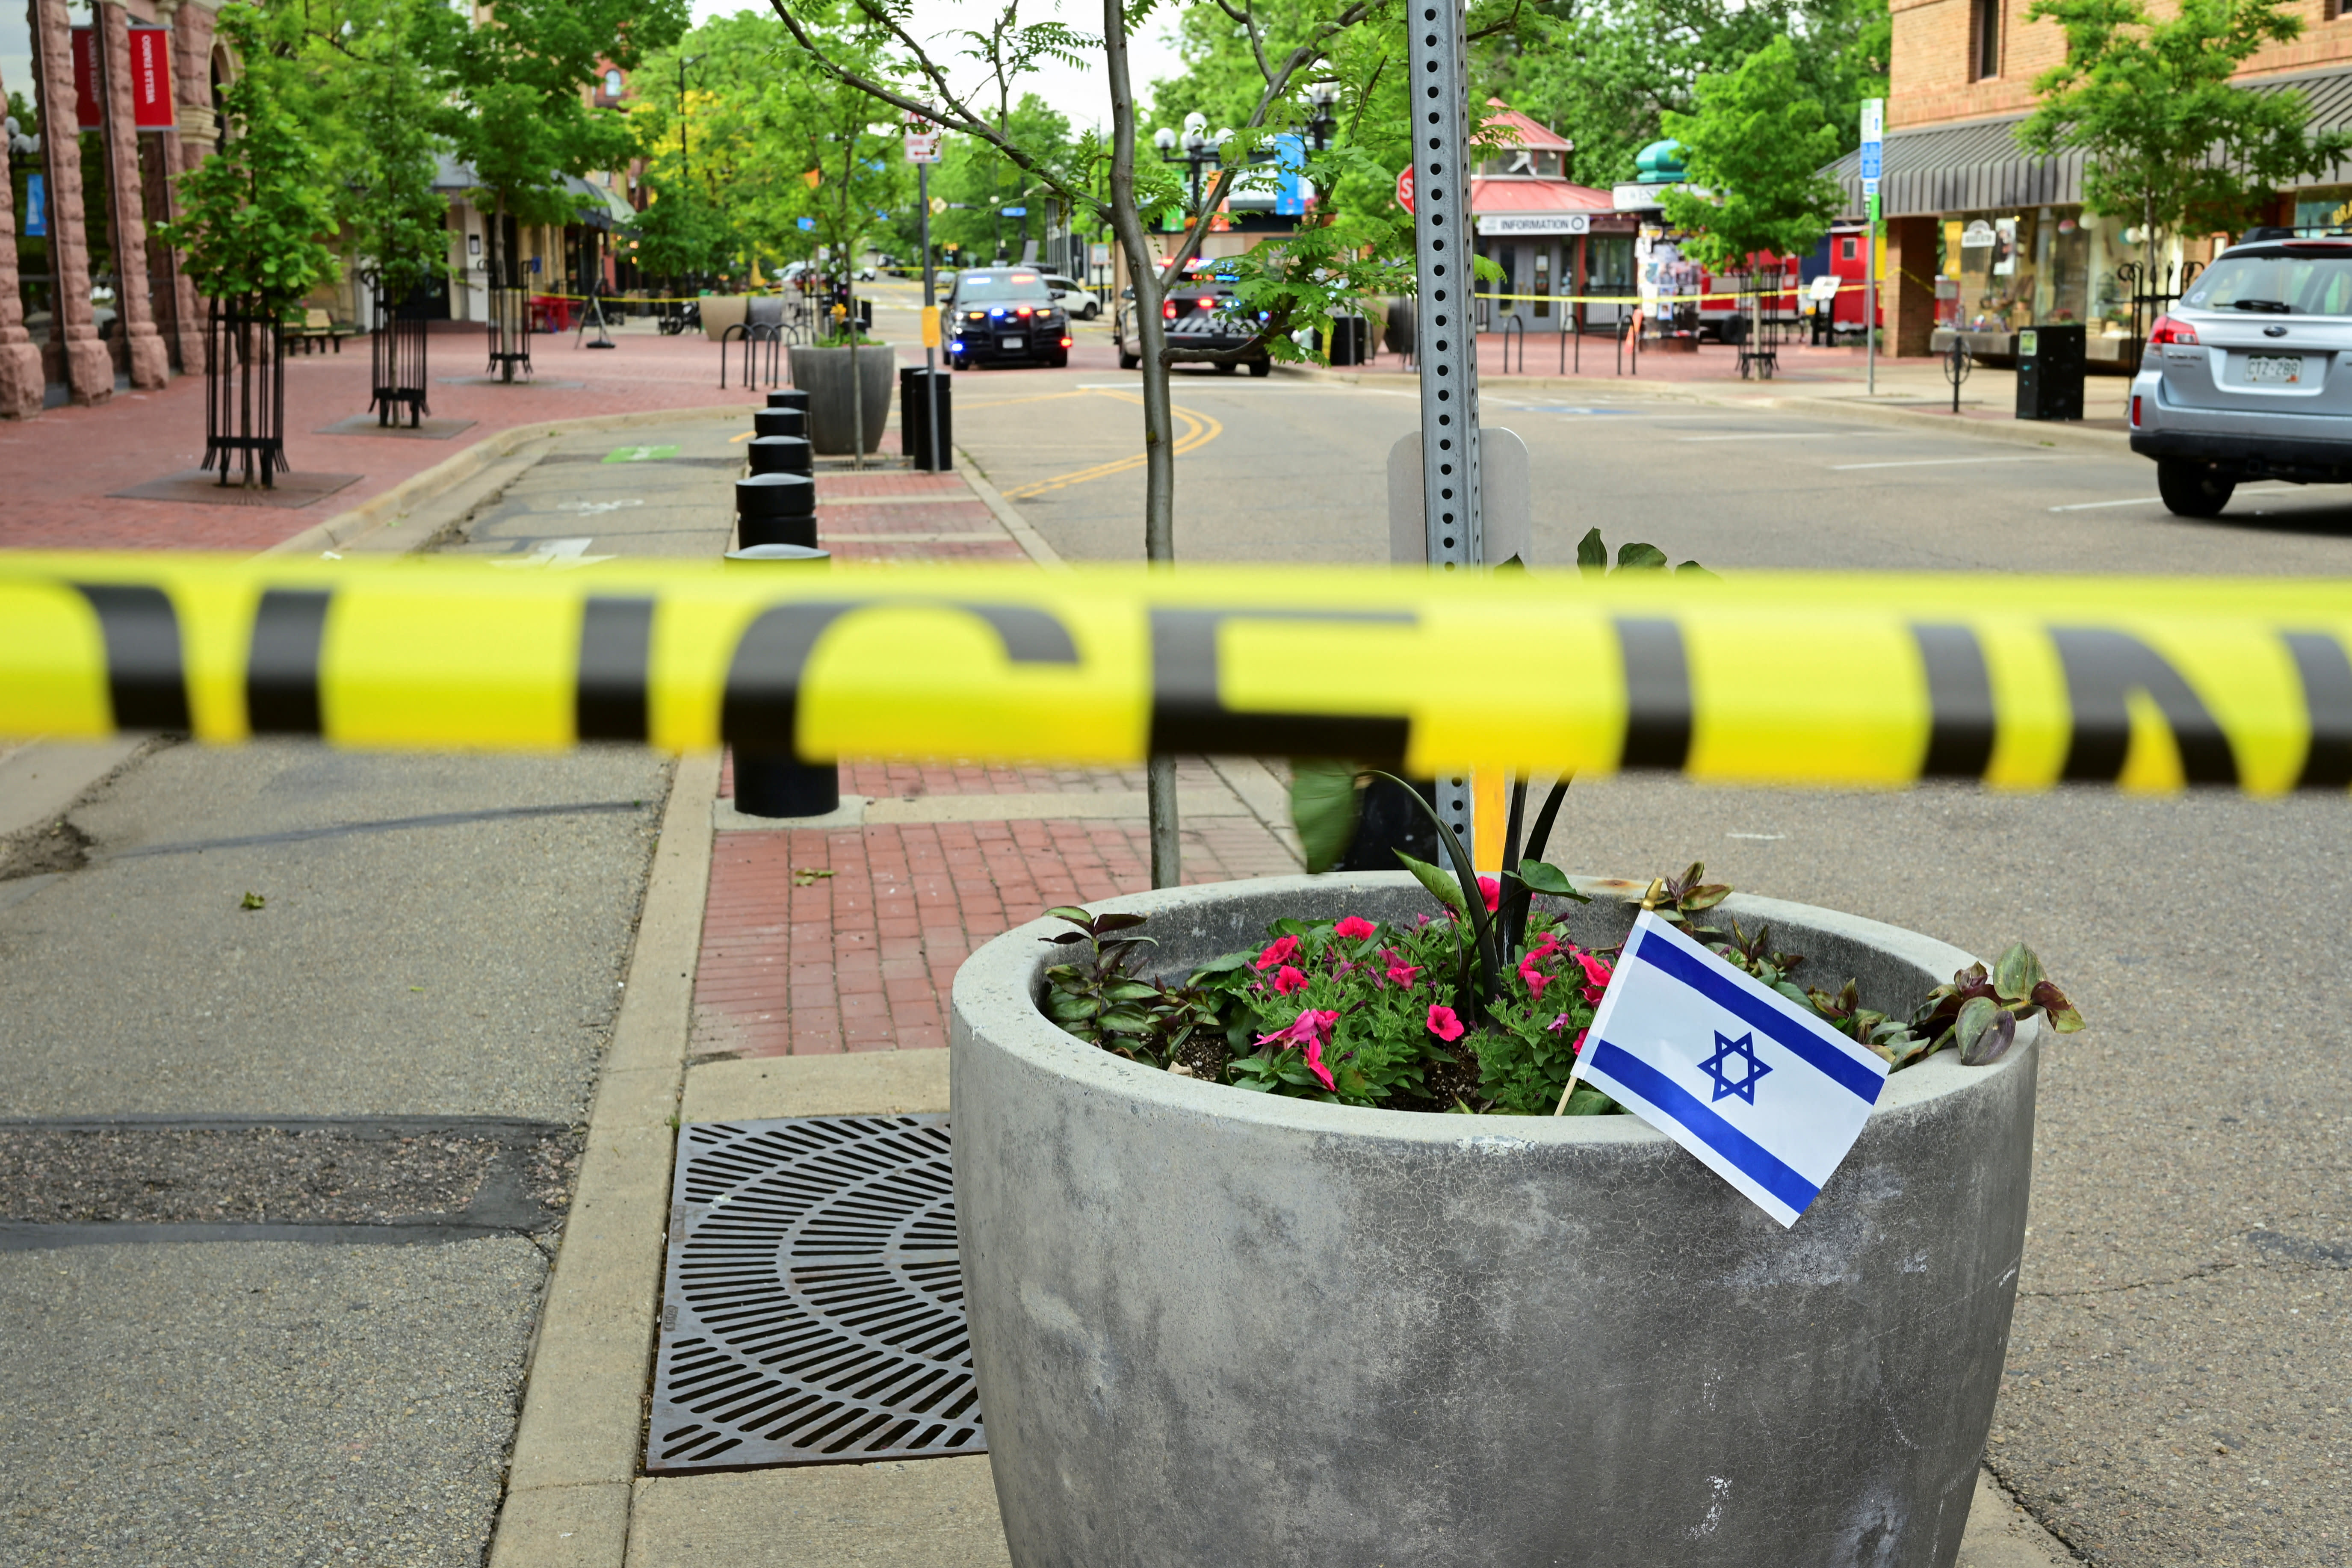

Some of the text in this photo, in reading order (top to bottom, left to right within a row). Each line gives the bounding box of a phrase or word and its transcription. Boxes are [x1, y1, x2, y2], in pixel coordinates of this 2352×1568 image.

[142, 35, 155, 104] WELLS FARGO
[1500, 219, 1569, 230] INFORMATION
